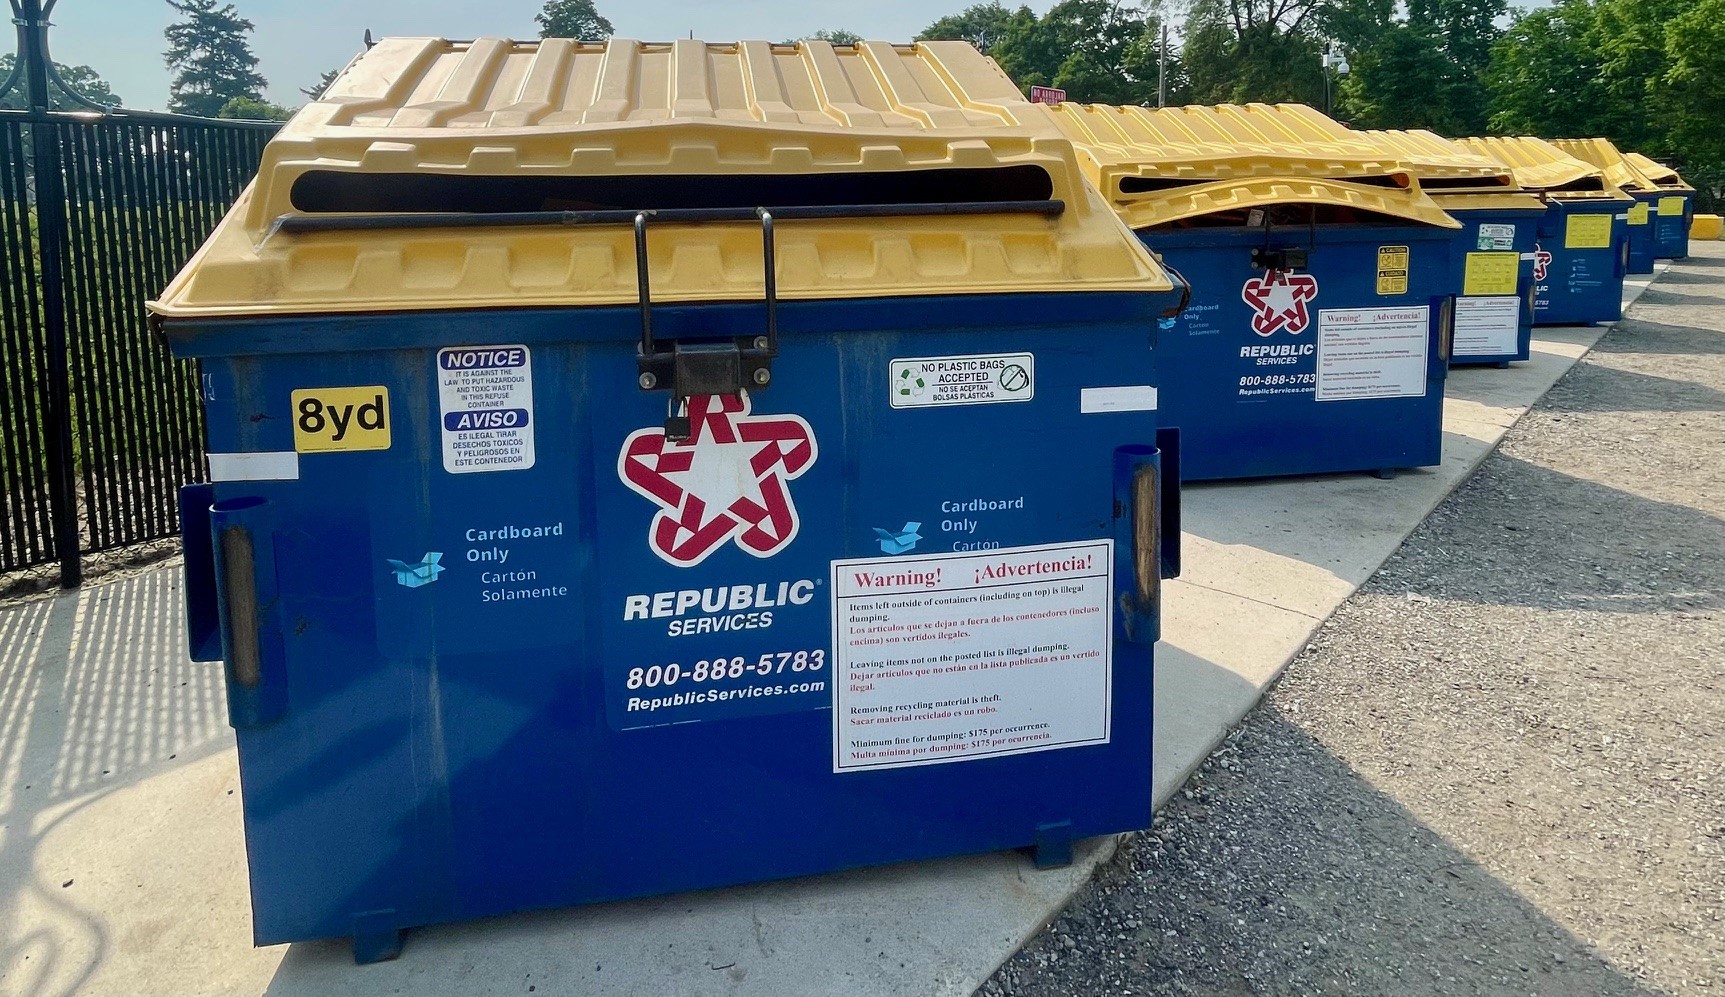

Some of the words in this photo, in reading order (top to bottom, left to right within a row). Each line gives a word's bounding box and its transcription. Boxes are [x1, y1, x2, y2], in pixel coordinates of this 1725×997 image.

[1327, 314, 1361, 322] Warning!
[1373, 312, 1420, 322] ¡Advertencia!
[1240, 344, 1314, 357] REPUBLIC
[448, 350, 520, 368] NOTICE
[922, 364, 936, 372] NO
[938, 362, 978, 372] PLASTIC
[980, 360, 1005, 369] BAGS
[1256, 357, 1297, 365] SERVICES
[486, 376, 524, 384] HAZARDOUS
[938, 372, 988, 383] ACCEPTED
[1239, 374, 1315, 386] 800-888-5783
[299, 395, 384, 441] 8yd
[458, 411, 517, 429] AVISO
[453, 441, 491, 449] DESECHOS
[464, 448, 509, 457] PELIGROSOS
[475, 456, 522, 464] CONTENEDOR
[942, 497, 1024, 513] Cardboard
[466, 522, 563, 541] Cardboard
[942, 518, 977, 533] Only
[953, 538, 999, 552] Cartón
[466, 547, 509, 563] Only
[482, 569, 536, 583] Cartón
[855, 568, 941, 588] Warning!
[974, 555, 1092, 584] ¡Advertencia!
[482, 586, 567, 602] Solamente
[875, 602, 889, 610] left
[892, 600, 921, 608] outside
[924, 598, 933, 606] of
[935, 596, 977, 605] containers
[980, 592, 1020, 602] (including
[1035, 588, 1050, 598] top)
[1060, 584, 1084, 594] illegal
[668, 612, 773, 636] SERVICES
[850, 614, 890, 623] dumping.
[935, 620, 958, 629] dejan
[1016, 610, 1067, 620] contenedores
[1069, 606, 1099, 616] (incluso
[850, 636, 883, 646] encima)
[902, 633, 935, 642] vertidos
[938, 630, 970, 640] ilegales.
[850, 660, 884, 669] Leaving
[955, 651, 981, 662] posted
[984, 650, 996, 658] list
[1007, 646, 1030, 655] illegal
[1032, 643, 1069, 653] dumping.
[626, 649, 825, 690] 800-888-5783
[850, 673, 874, 681] Dejar
[945, 664, 966, 672] están
[990, 660, 1007, 668] lista
[1009, 656, 1048, 668] publicada
[1072, 650, 1100, 659] vertido
[627, 681, 825, 711] RepublicServices.com
[850, 684, 875, 692] ilegal.
[850, 705, 893, 714] Removing
[895, 702, 933, 711] recycling
[936, 697, 970, 707] material
[981, 694, 1001, 703] theft.
[850, 718, 874, 726] Sacar
[877, 715, 912, 724] material
[915, 711, 951, 720] reciclado
[851, 740, 892, 748] Minimum
[895, 737, 910, 745] fine
[927, 732, 966, 742] dumping:
[969, 729, 988, 737] $175
[990, 728, 1003, 736] per
[1005, 723, 1050, 733] occurrence.
[851, 751, 876, 759] Multa
[912, 748, 927, 756] por
[929, 741, 969, 752] dumping:
[971, 739, 990, 748] $175
[1008, 732, 1052, 742] ocurrencia.
